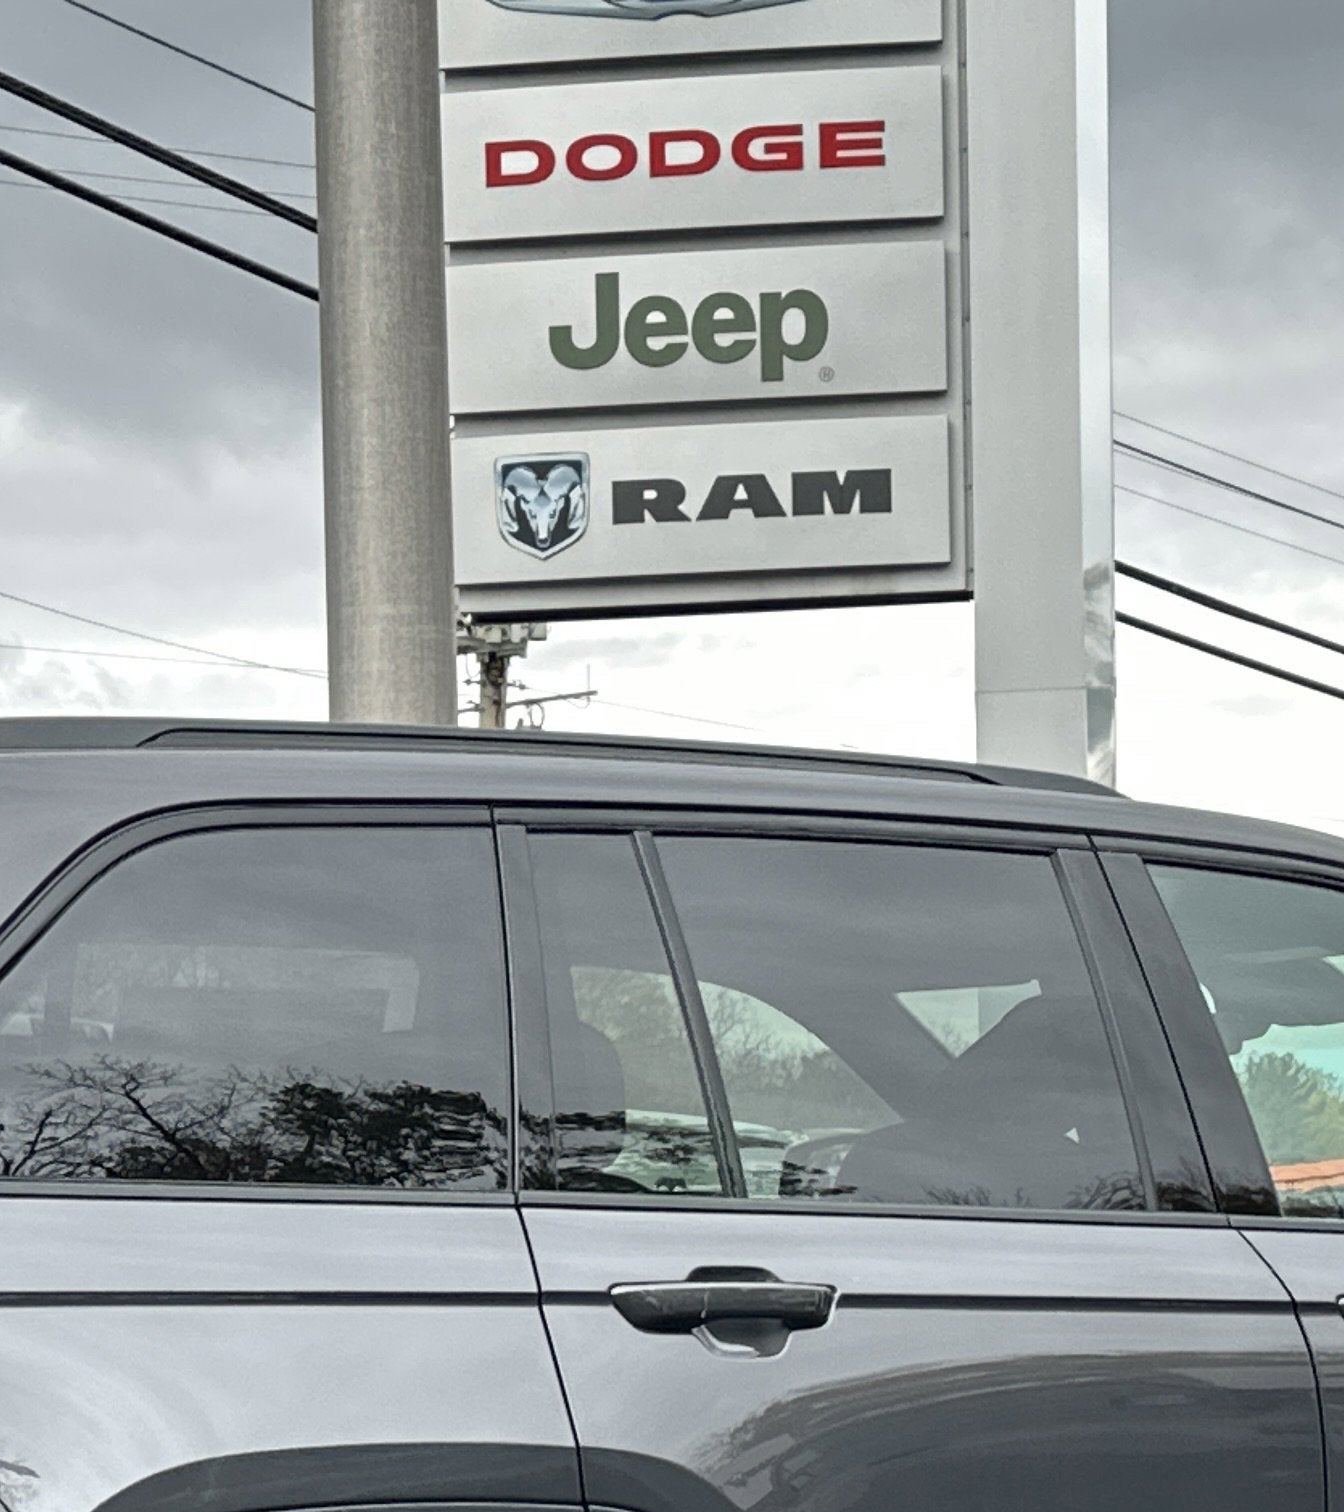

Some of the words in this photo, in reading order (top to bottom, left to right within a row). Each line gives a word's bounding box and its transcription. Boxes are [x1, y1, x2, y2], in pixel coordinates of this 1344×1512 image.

[485, 119, 886, 188] DODGE
[548, 272, 829, 382] Jeep
[612, 467, 893, 525] RAM
